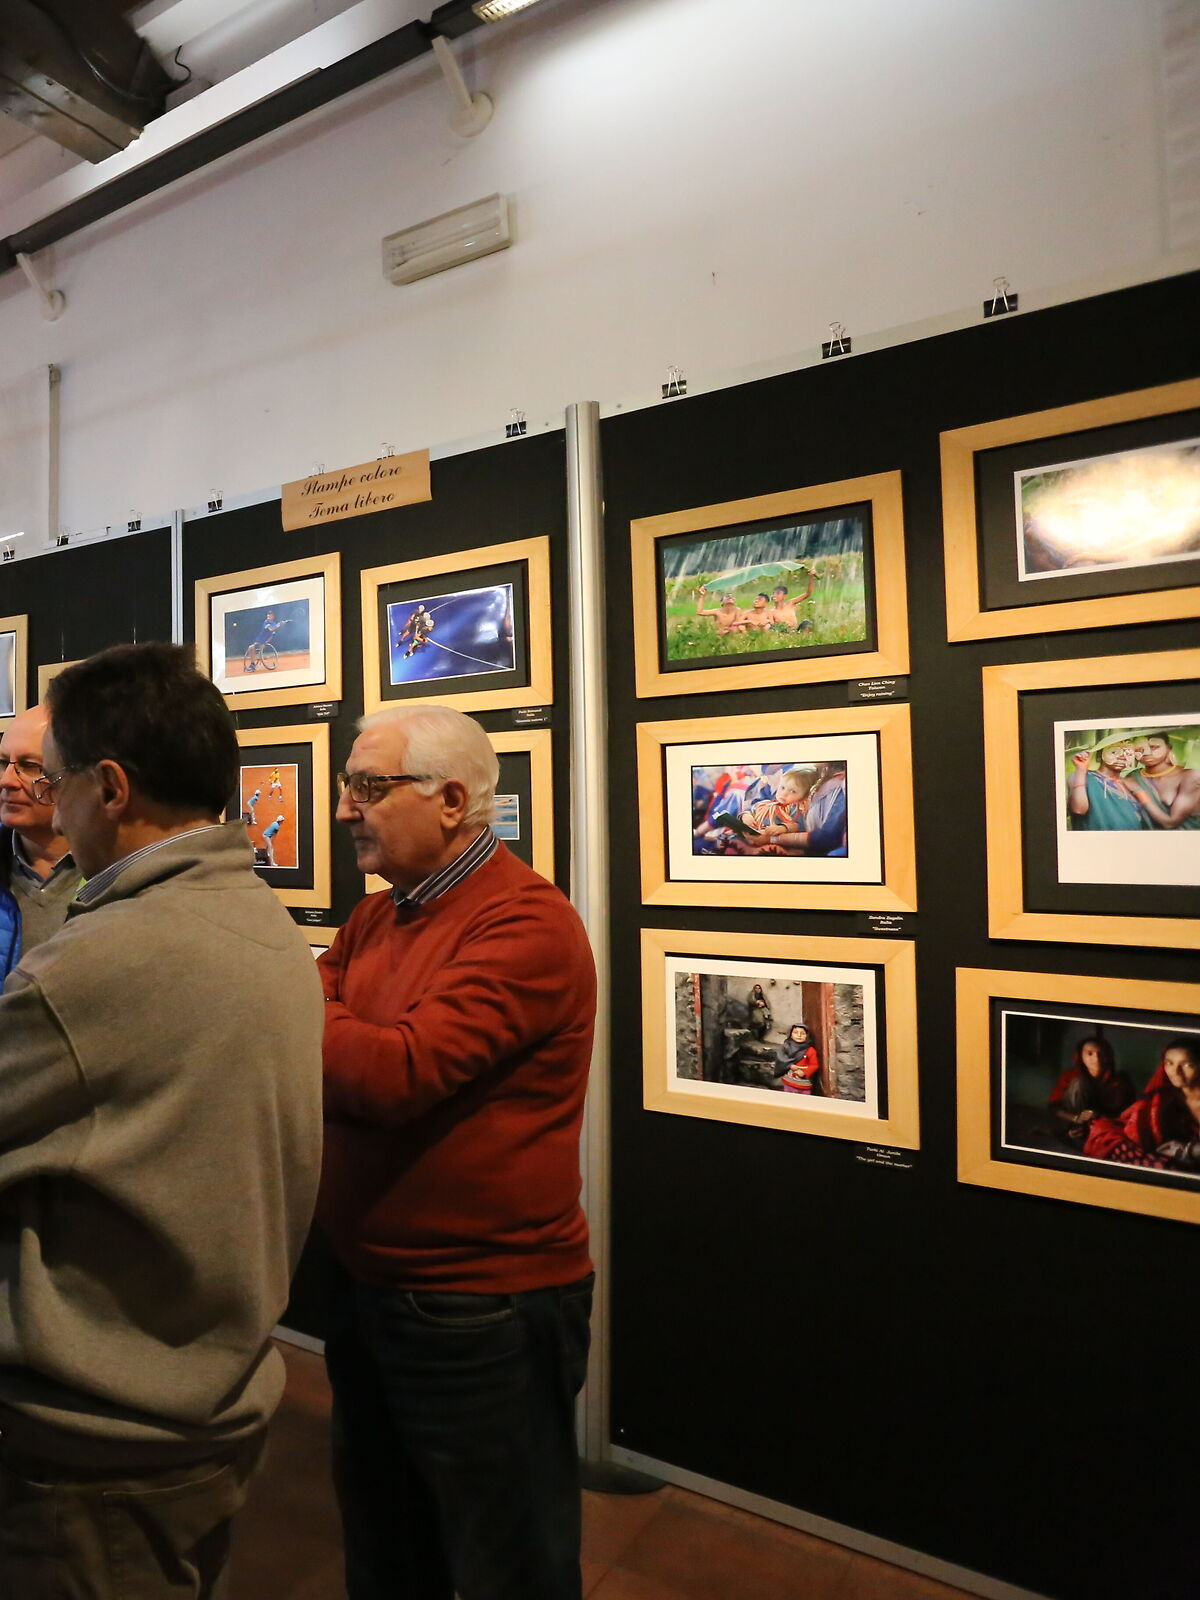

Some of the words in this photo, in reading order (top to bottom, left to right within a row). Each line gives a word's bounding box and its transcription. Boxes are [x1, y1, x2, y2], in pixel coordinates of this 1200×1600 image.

[301, 474, 355, 496] Stampe
[359, 464, 403, 483] colore
[308, 502, 350, 519] Tema
[354, 491, 396, 510] libero
